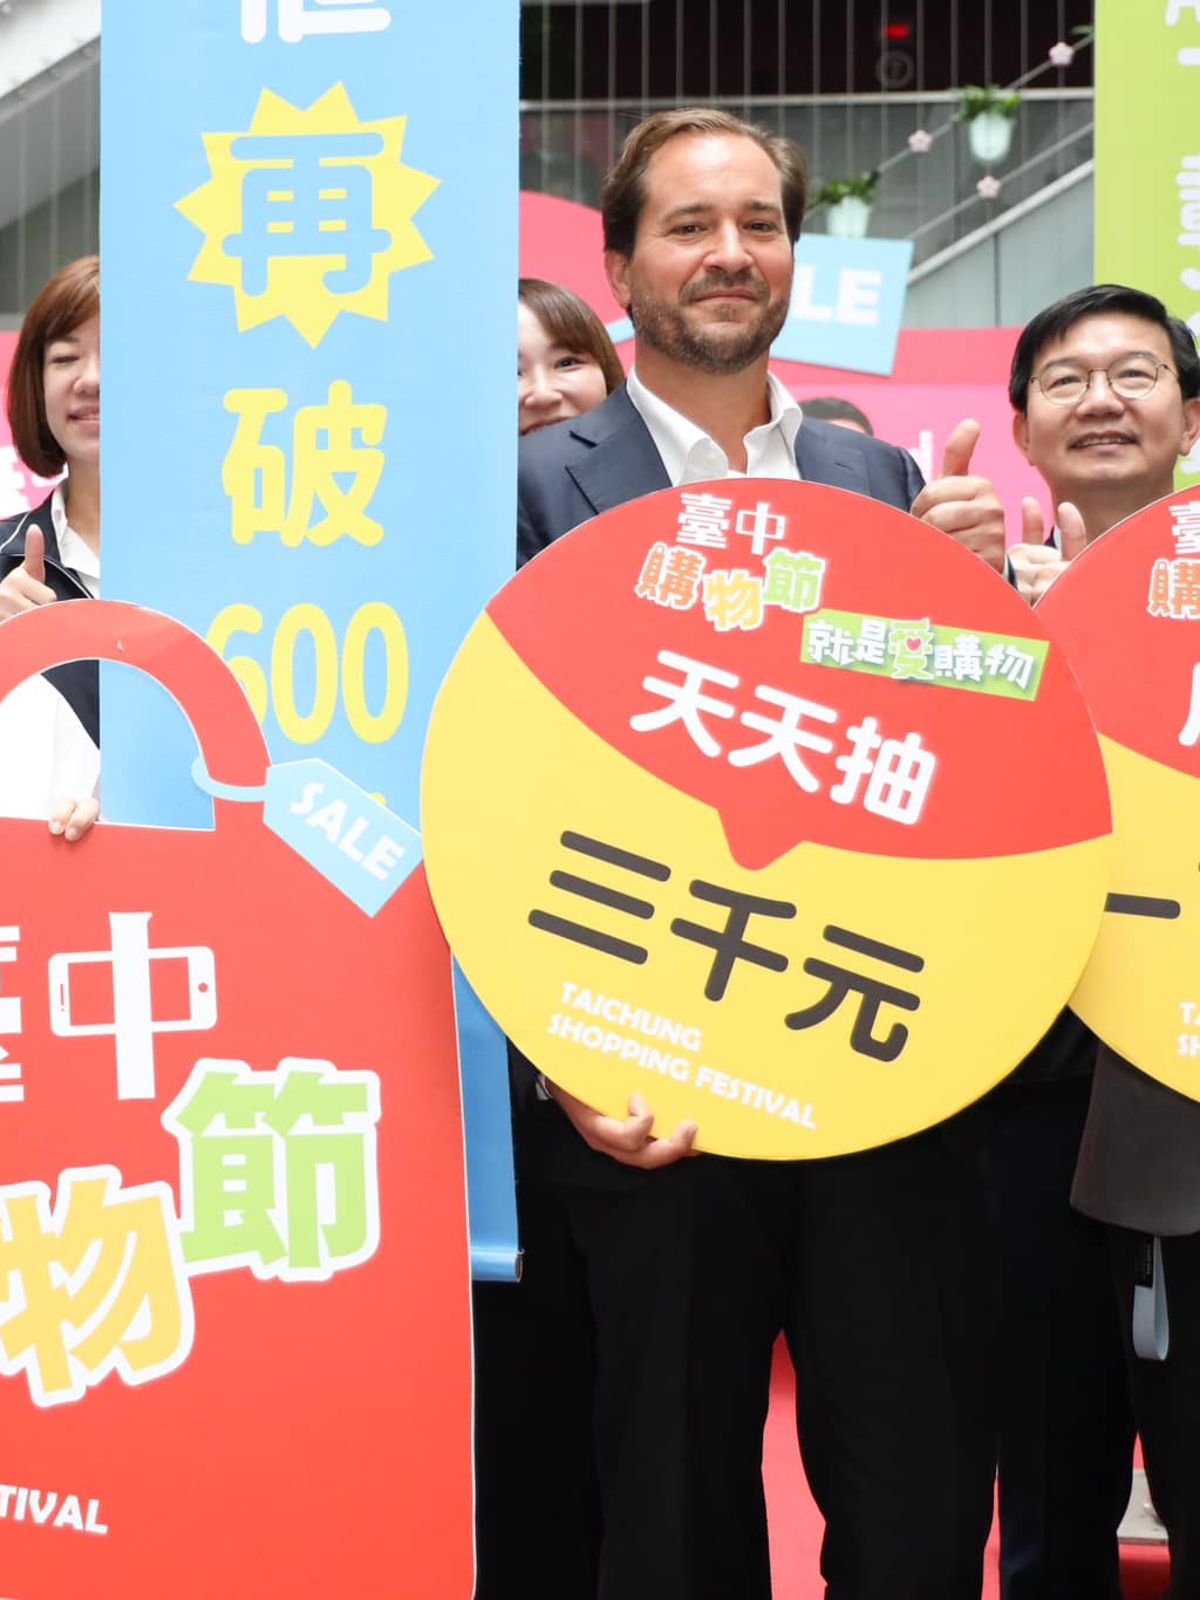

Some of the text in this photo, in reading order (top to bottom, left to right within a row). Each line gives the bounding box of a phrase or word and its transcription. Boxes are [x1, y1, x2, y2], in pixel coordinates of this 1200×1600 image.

[790, 264, 884, 326] LE
[676, 493, 785, 555] 臺中
[634, 541, 826, 631] 購物節
[806, 617, 1036, 690] 就是愛購物
[629, 650, 936, 825] 天天抽
[290, 782, 406, 882] SALE
[528, 830, 924, 1062] 三千元
[560, 982, 702, 1052] TAICHUNG
[547, 1013, 817, 1132] SHOPPING FESTIVAL
